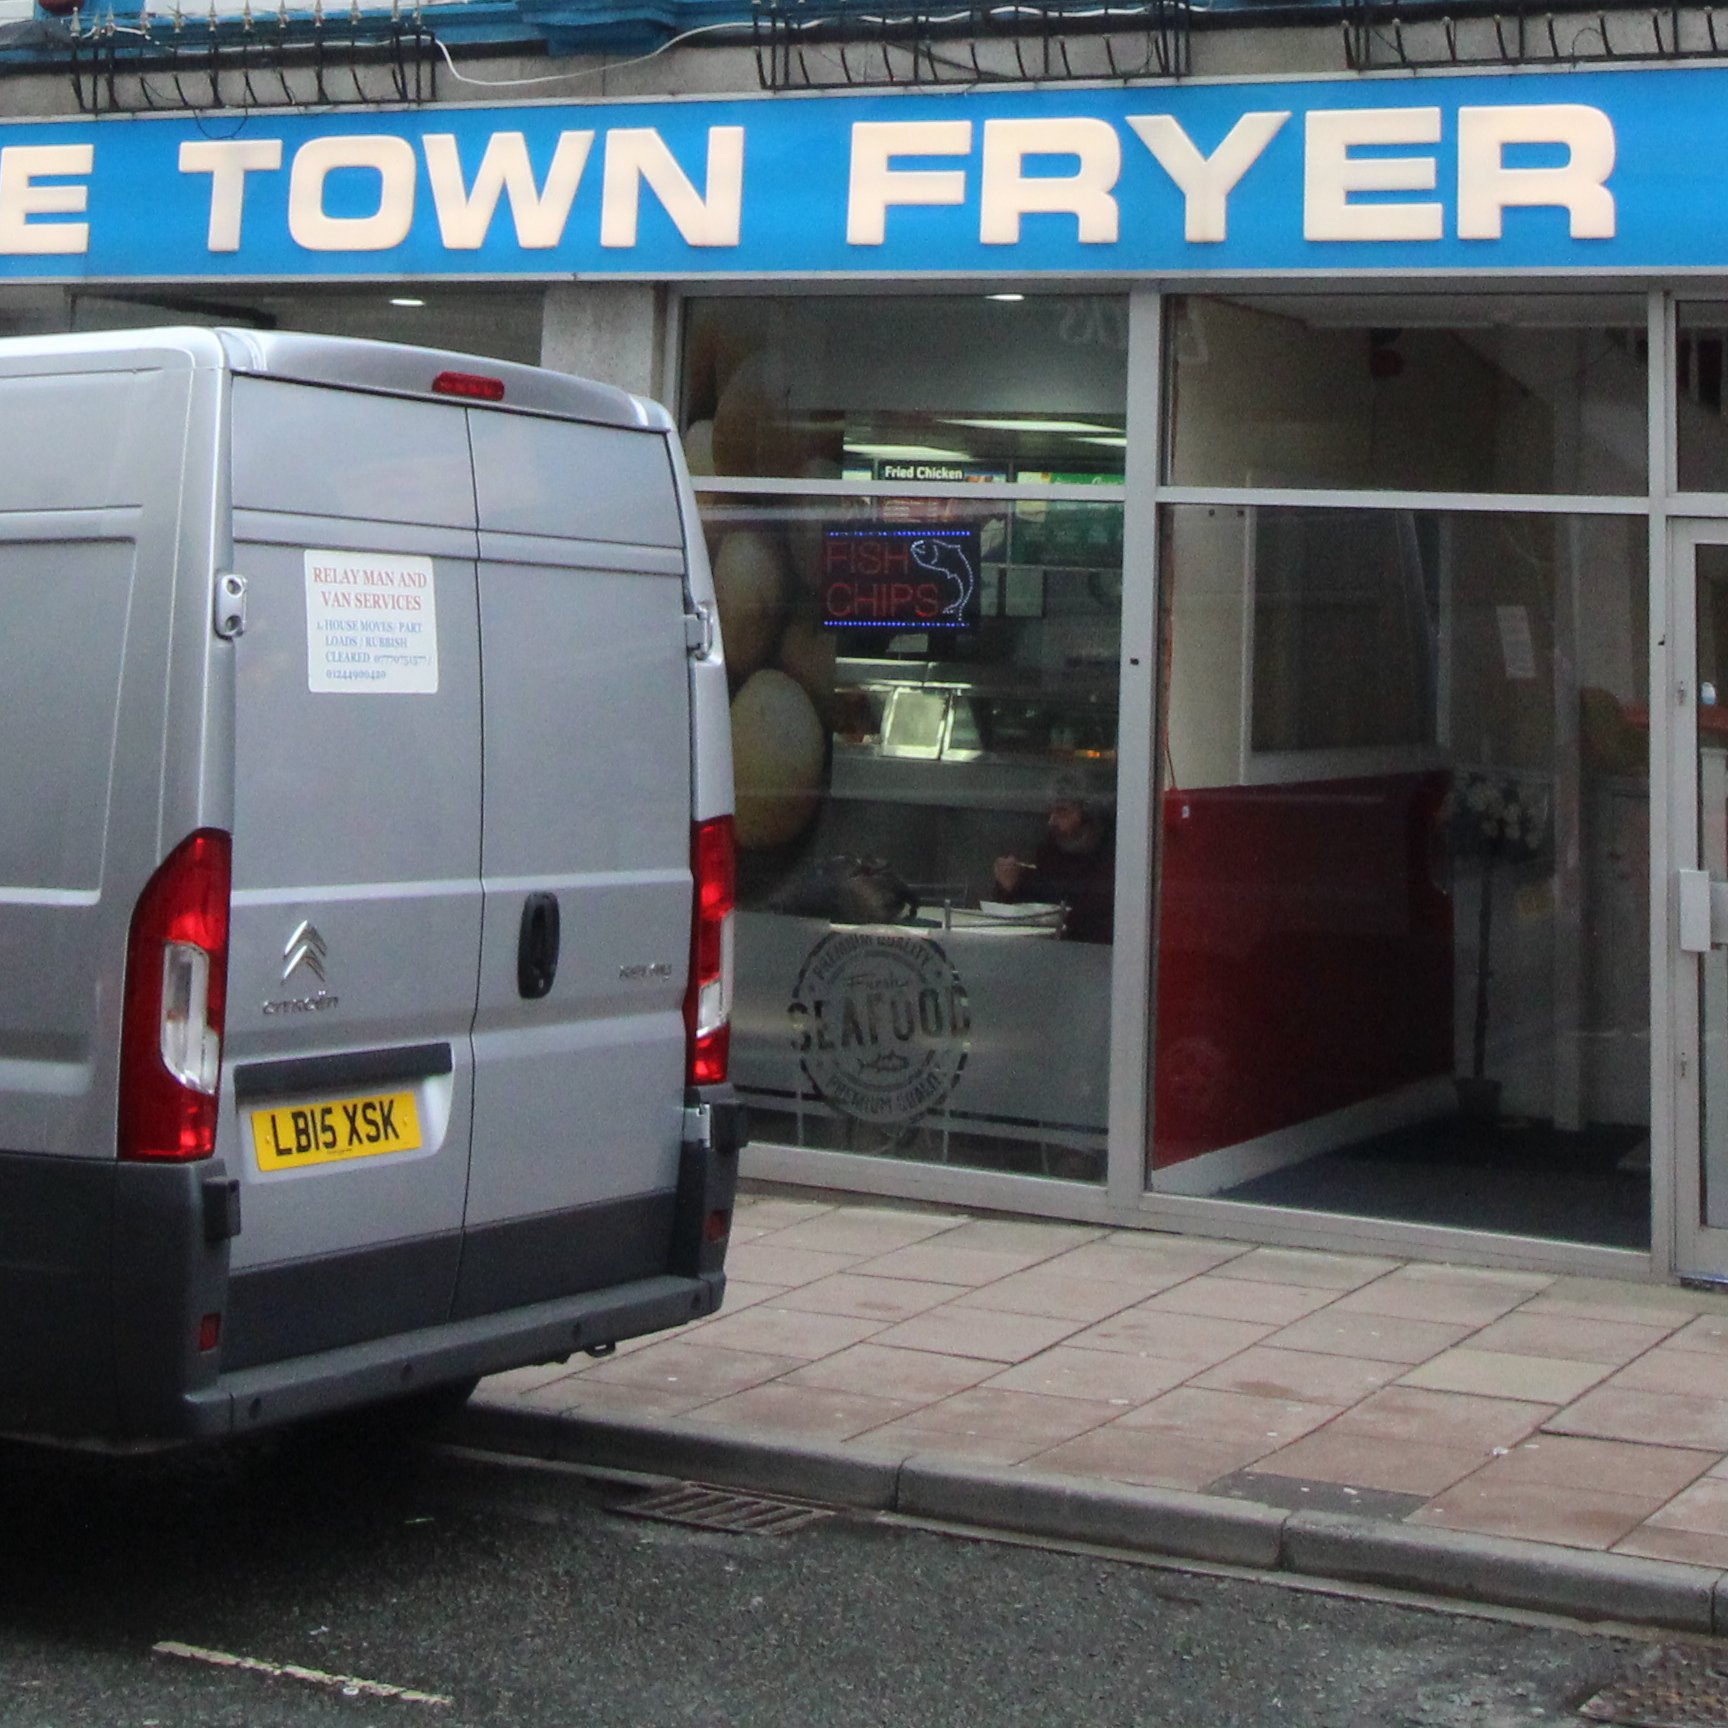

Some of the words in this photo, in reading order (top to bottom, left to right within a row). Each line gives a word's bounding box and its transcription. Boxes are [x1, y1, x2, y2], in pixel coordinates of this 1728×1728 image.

[178, 126, 742, 253] TOWN
[845, 104, 1616, 246] FRYER
[884, 465, 914, 479] Fried
[916, 465, 963, 480] Chicken
[826, 541, 909, 571] FISH
[312, 567, 361, 586] RELAY
[363, 569, 395, 587] MAN
[398, 571, 428, 589] AND
[321, 590, 352, 609] VAN
[354, 592, 423, 611] SERVICES
[825, 582, 940, 618] CHIPS
[324, 619, 358, 632] HOUSE
[399, 621, 422, 634] PART
[325, 635, 358, 647] LOADS
[365, 636, 408, 648] RUBBISH
[325, 651, 371, 663] CLEARED
[271, 1106, 337, 1157] LB15
[342, 1099, 400, 1146] XSK
